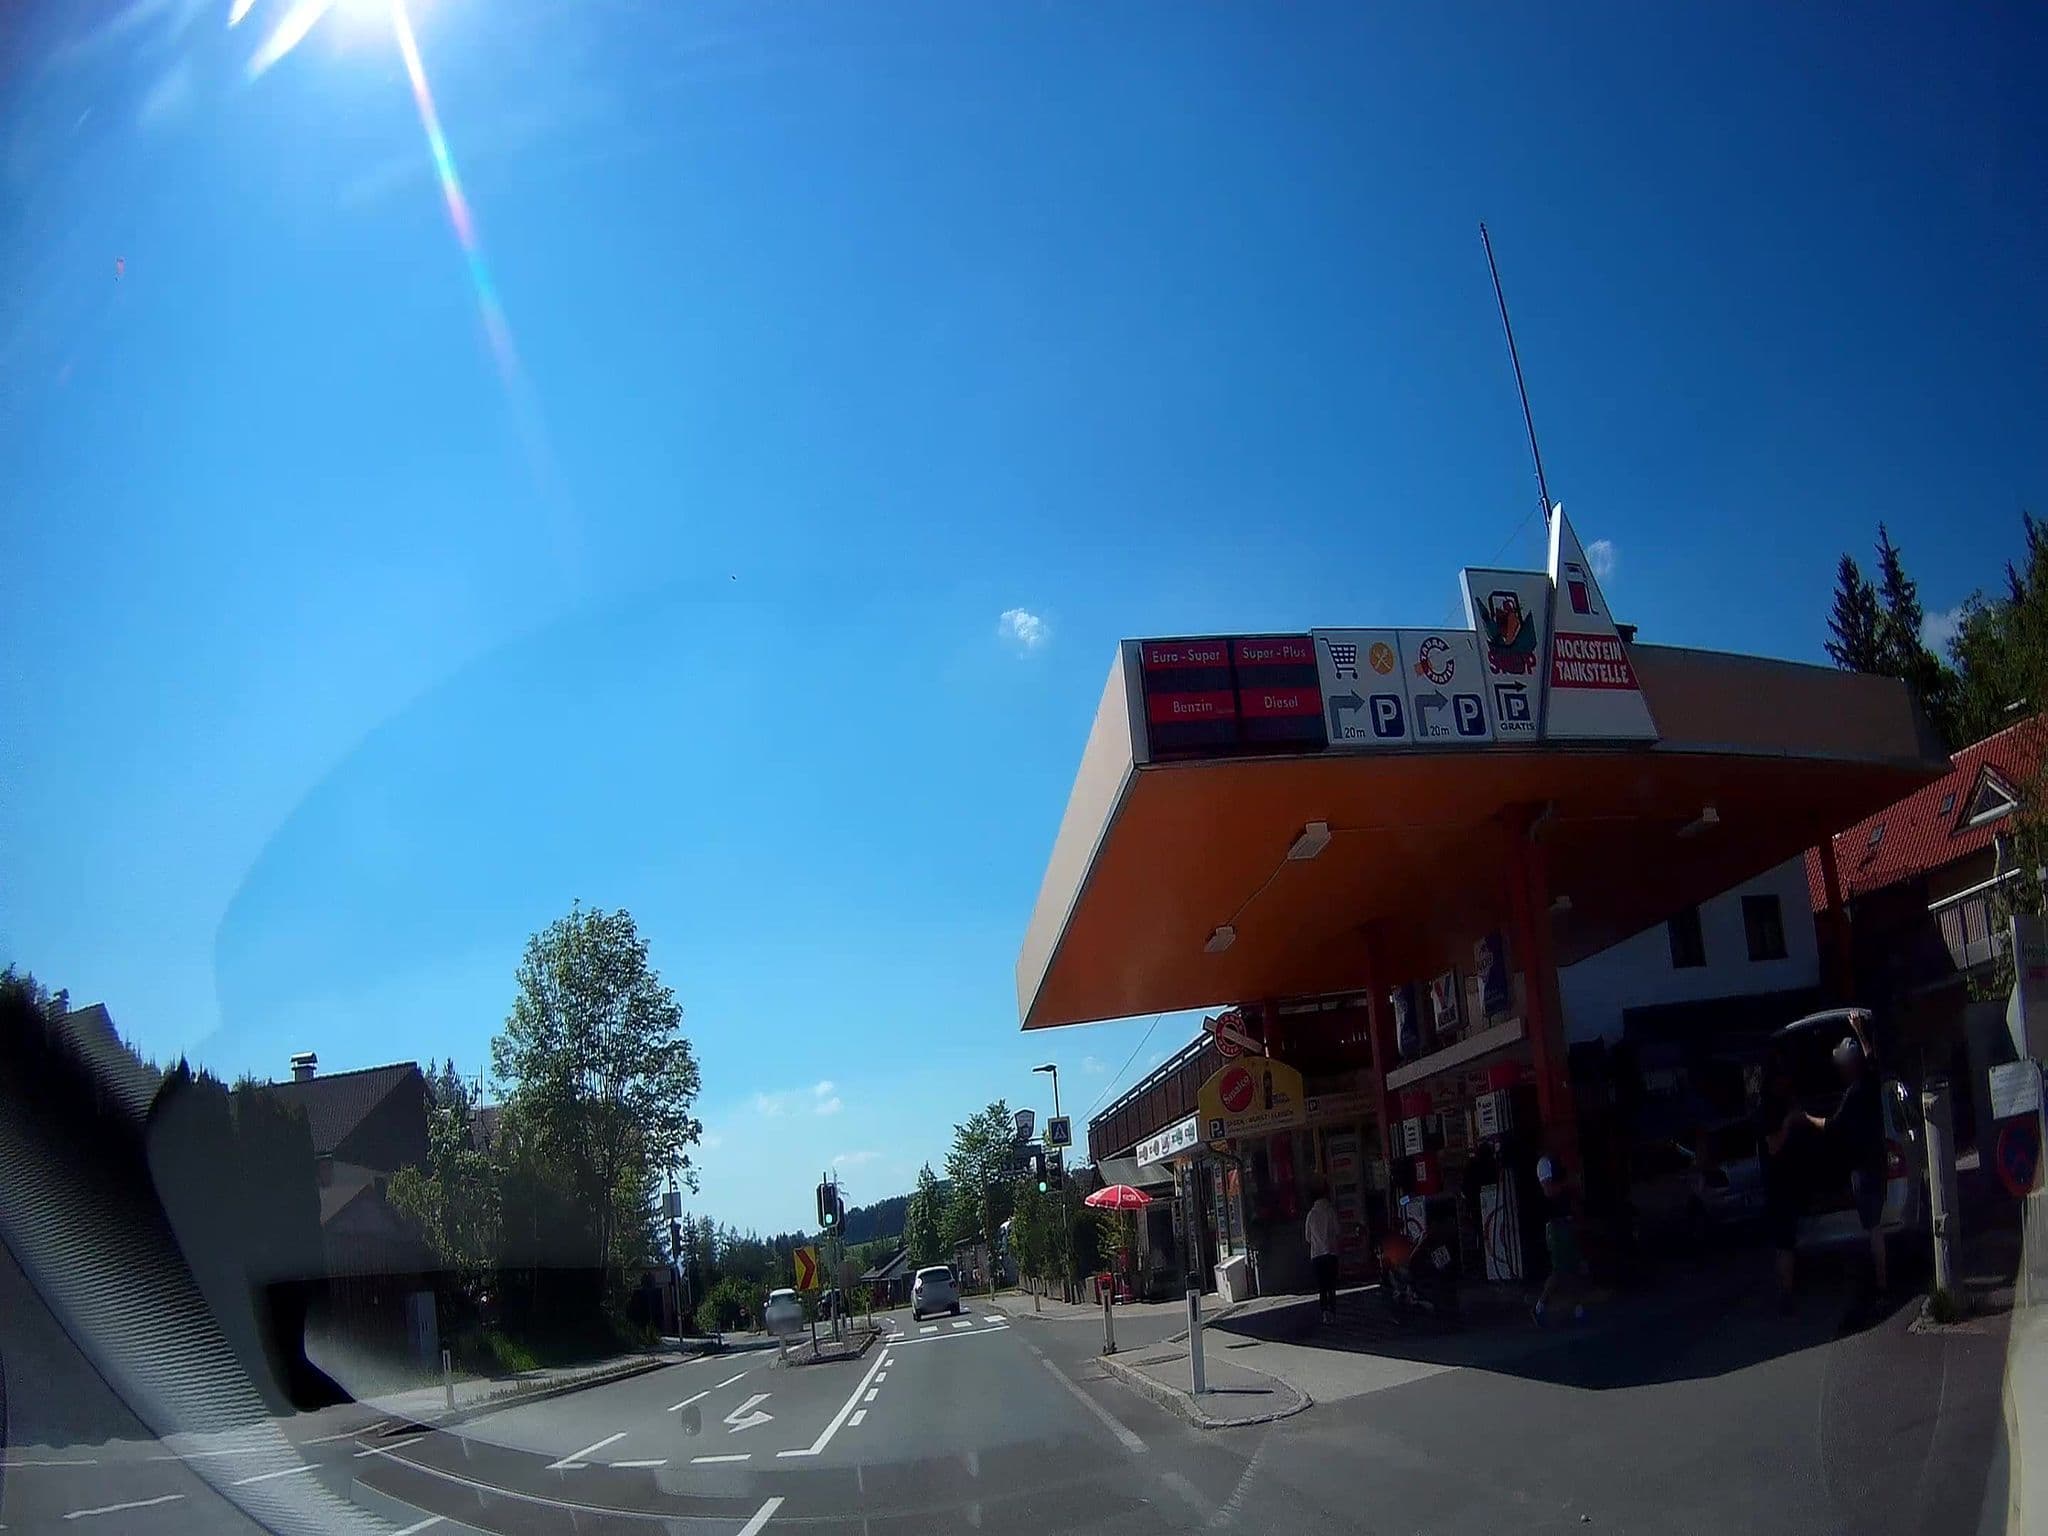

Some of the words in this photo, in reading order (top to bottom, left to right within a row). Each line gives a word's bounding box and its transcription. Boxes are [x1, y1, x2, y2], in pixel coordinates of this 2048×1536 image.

[1556, 639, 1622, 661] NOCKSTEIN
[1555, 661, 1629, 684] TANKSTELLE
[1173, 699, 1213, 713] Benzin
[1264, 696, 1298, 709] Diesel
[1510, 698, 1524, 717] P
[1376, 698, 1397, 734] P
[1458, 697, 1479, 732] P
[1344, 726, 1366, 739] 20m
[1430, 725, 1450, 737] 20m
[1500, 722, 1535, 731] GRATIS
